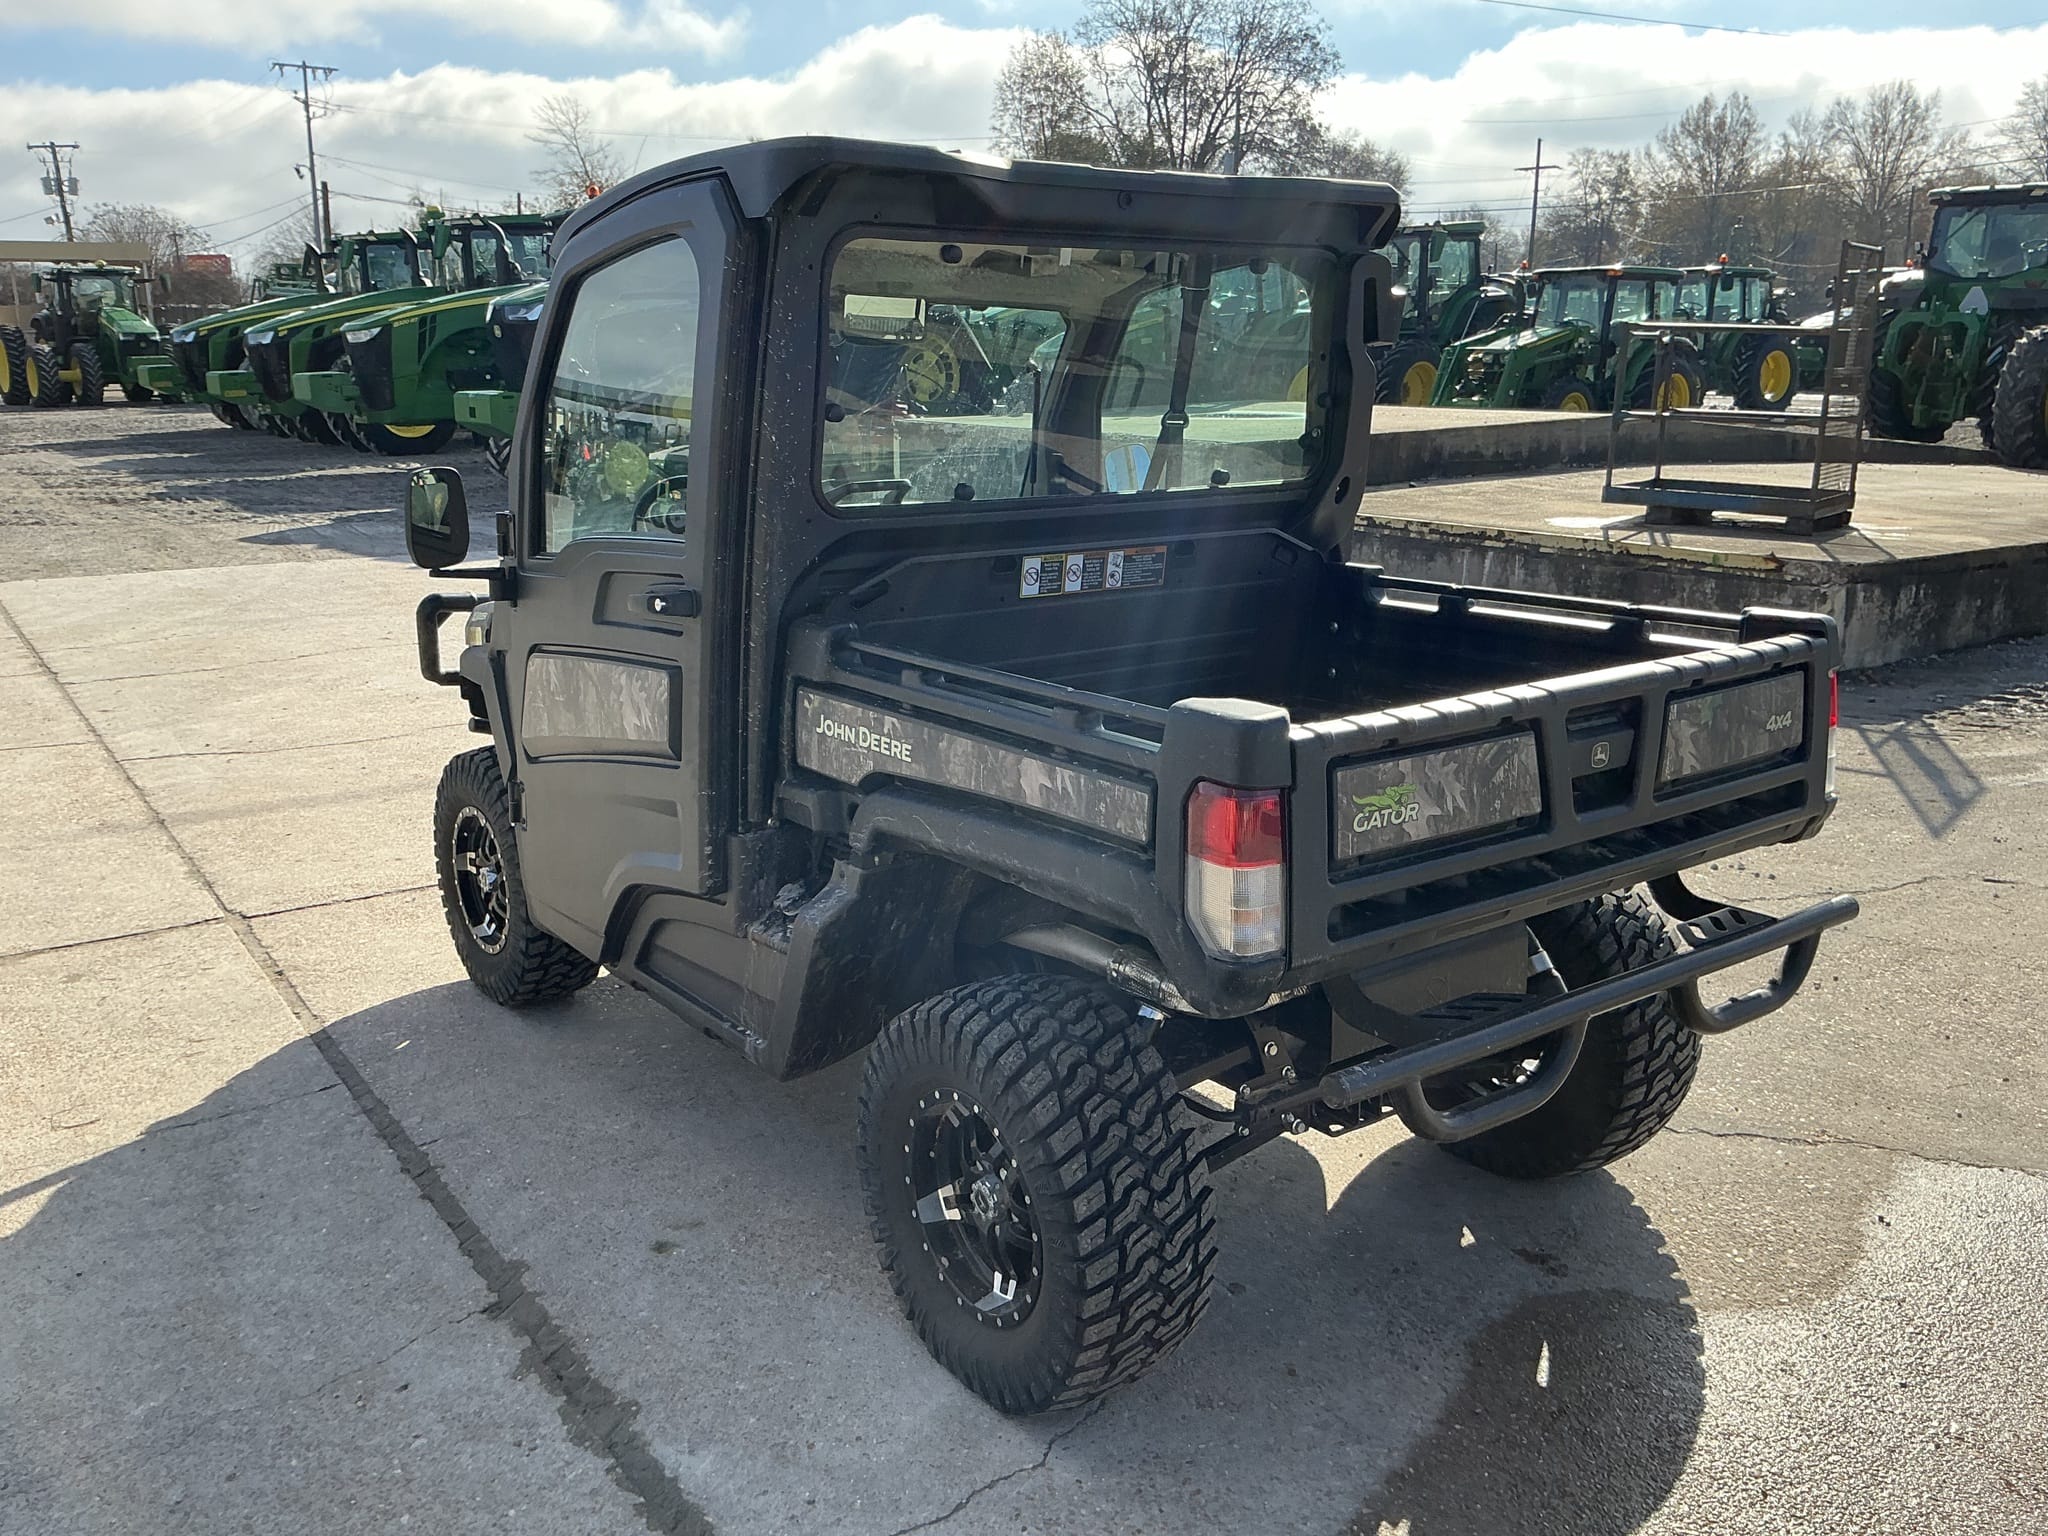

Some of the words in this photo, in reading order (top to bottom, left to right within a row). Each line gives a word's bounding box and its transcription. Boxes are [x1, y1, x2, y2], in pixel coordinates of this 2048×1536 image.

[816, 714, 856, 744] JOHN
[859, 727, 913, 763] DEERE
[1353, 803, 1420, 833] GATOR
